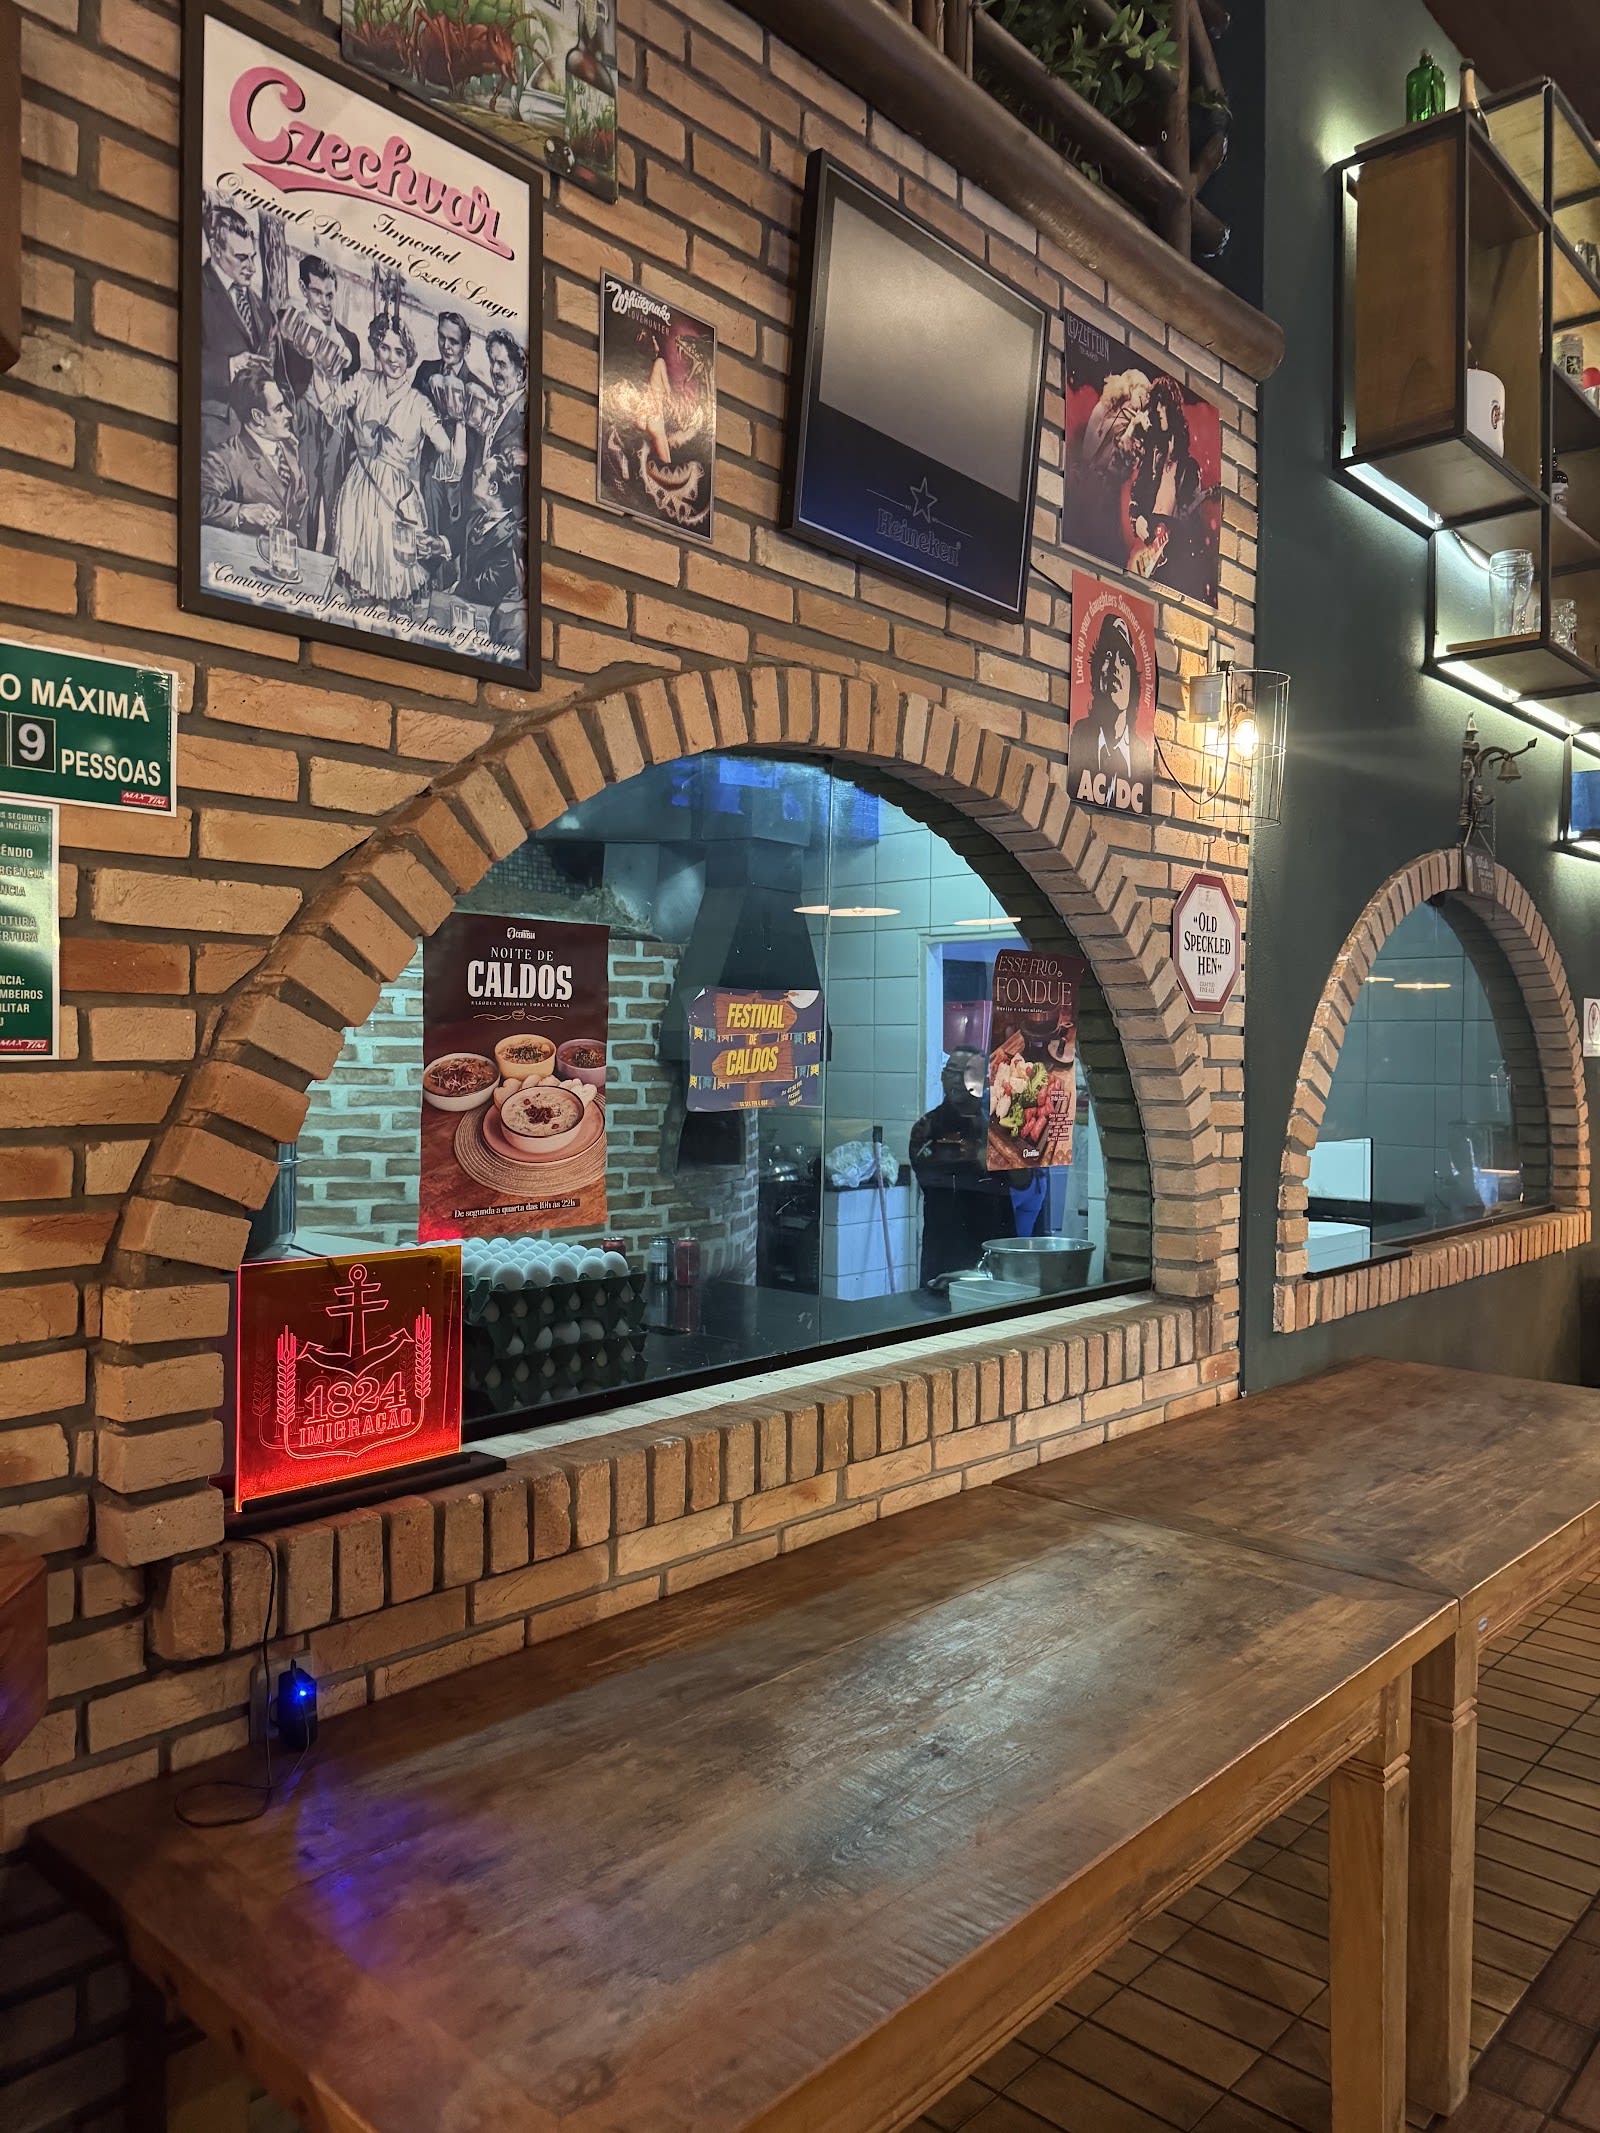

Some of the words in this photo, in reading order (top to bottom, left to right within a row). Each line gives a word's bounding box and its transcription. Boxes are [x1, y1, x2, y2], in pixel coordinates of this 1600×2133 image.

[229, 66, 504, 247] Czechvar
[216, 172, 314, 225] Original
[312, 214, 402, 270] Premium
[407, 254, 462, 295] Czech
[461, 280, 518, 319] Lager
[373, 213, 461, 265] Imported
[604, 281, 672, 326] Whitesnake
[627, 309, 670, 336] LOVEHUNTER
[213, 561, 276, 598] Coming
[276, 583, 294, 597] to
[289, 592, 325, 606] you
[316, 593, 361, 615] from
[361, 604, 386, 620] the
[387, 613, 418, 633] very
[418, 616, 456, 640] heart
[455, 627, 476, 646] of
[472, 630, 516, 657] Europe
[1088, 591, 1118, 617] daughters
[1118, 594, 1141, 633] Summer
[1079, 611, 1093, 640] your
[1077, 638, 1087, 653] up
[1137, 629, 1153, 681] Vacation
[1074, 656, 1085, 685] Lock
[31, 677, 150, 723] MÁXIMA
[1143, 682, 1154, 706] Tour
[61, 748, 162, 787] PESSOAS
[1076, 769, 1144, 814] AC/DC
[8, 812, 47, 823] SEGUINTES
[490, 946, 532, 960] NOITE
[537, 949, 554, 961] DE
[1183, 930, 1231, 955] SPECKLED
[998, 955, 1029, 973] ESSE
[467, 960, 573, 1001] CALDOS
[996, 976, 1072, 1006] FONDUE
[726, 1003, 785, 1029] FESTIVAL
[749, 1034, 758, 1046] DE
[725, 1046, 779, 1076] CALDOS
[454, 1209, 465, 1218] De
[465, 1206, 495, 1219] segunda
[501, 1203, 525, 1216] quarta
[525, 1201, 539, 1210] das
[561, 1198, 576, 1208] 22h
[303, 1371, 407, 1425] 1824
